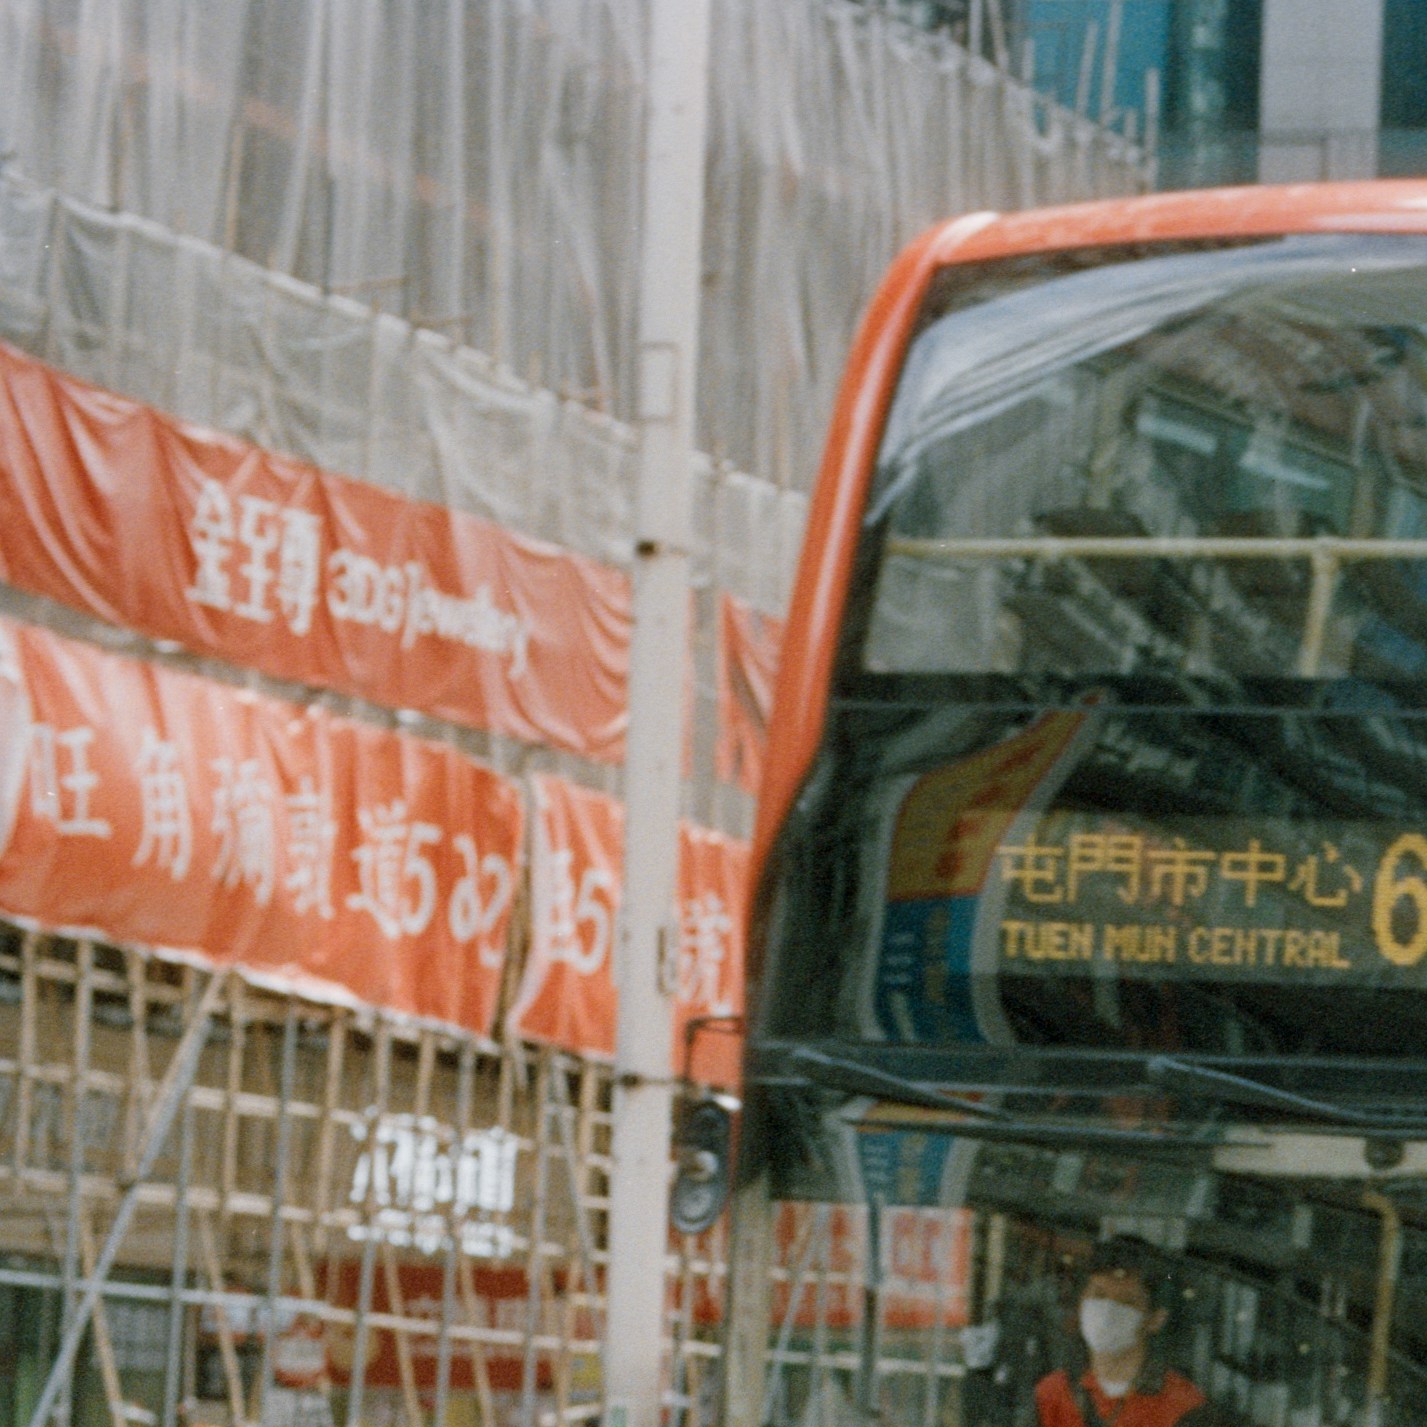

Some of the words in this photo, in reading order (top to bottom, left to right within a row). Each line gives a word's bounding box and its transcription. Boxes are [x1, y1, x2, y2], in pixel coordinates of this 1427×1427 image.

[996, 832, 1362, 908] 屯門市中心
[1000, 920, 1094, 962] TUEN
[1103, 923, 1178, 965] MUN
[1187, 927, 1352, 970] CENTRAL
